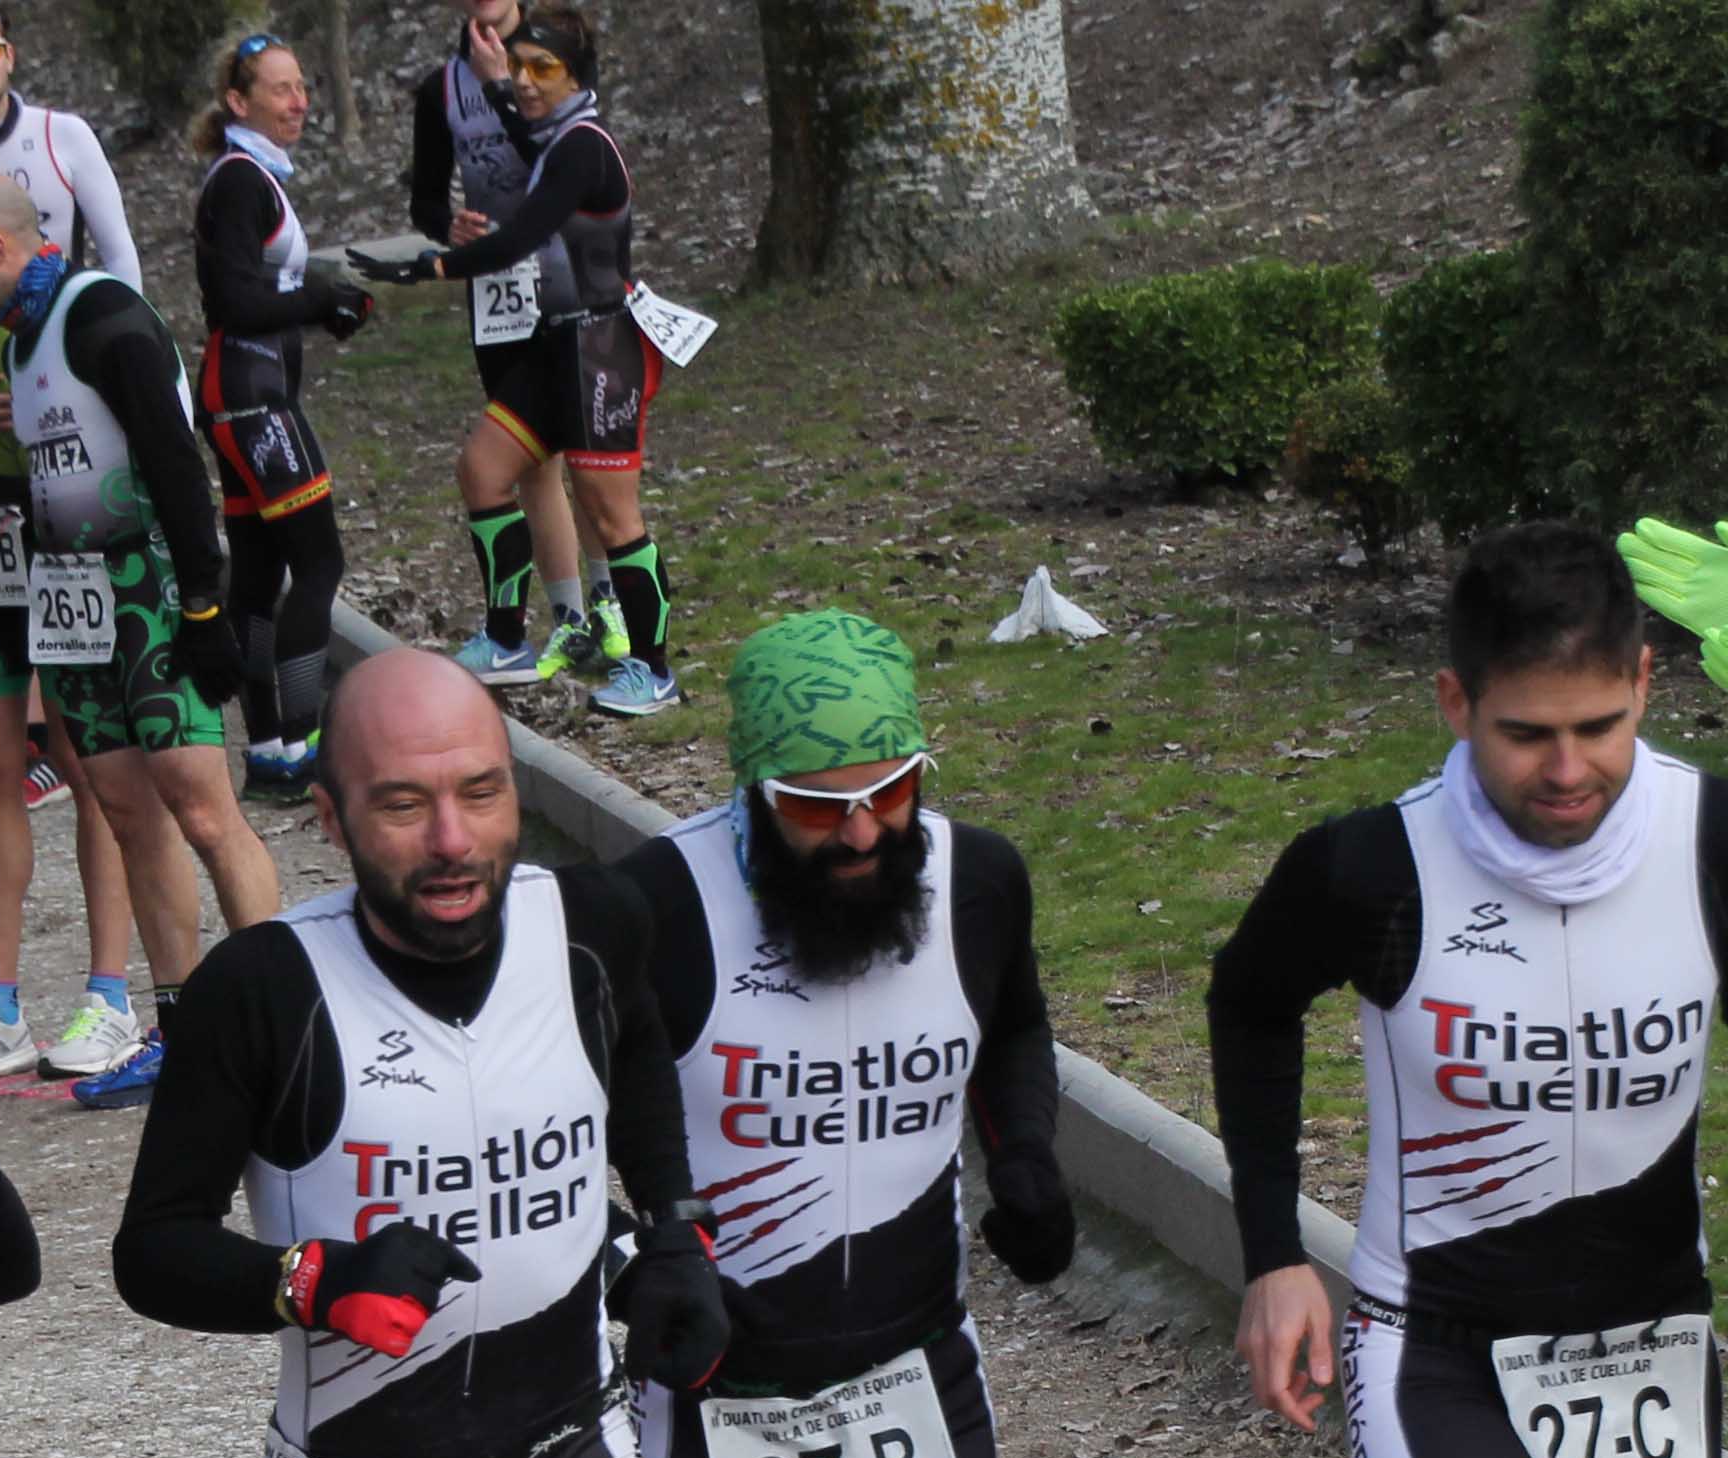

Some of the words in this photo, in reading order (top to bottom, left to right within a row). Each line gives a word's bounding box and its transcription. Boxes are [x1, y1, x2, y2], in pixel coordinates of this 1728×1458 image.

[486, 280, 540, 317] 25-
[481, 321, 534, 335] dorsalia
[37, 588, 103, 630] 26-D
[1442, 934, 1528, 963] Spiuk
[730, 973, 811, 1002] Spiuk
[1420, 997, 1704, 1062] Triatlón
[359, 1066, 437, 1093] Spiuk
[711, 1032, 970, 1099] Triatlón
[1435, 1059, 1692, 1113] Cuéllar
[719, 1092, 955, 1149] Cuéllar
[342, 1113, 596, 1198] Triatlón
[1559, 1345, 1607, 1364] CROS
[1605, 1340, 1636, 1358] POR
[1571, 1366, 1587, 1384] DE
[1590, 1358, 1653, 1381] CUELLAR
[723, 1408, 787, 1428] DUATLON
[864, 1366, 923, 1396] EQUIPOS
[761, 1422, 805, 1443] VILLA
[806, 1417, 824, 1434] DE
[827, 1402, 884, 1430] CUELLAR
